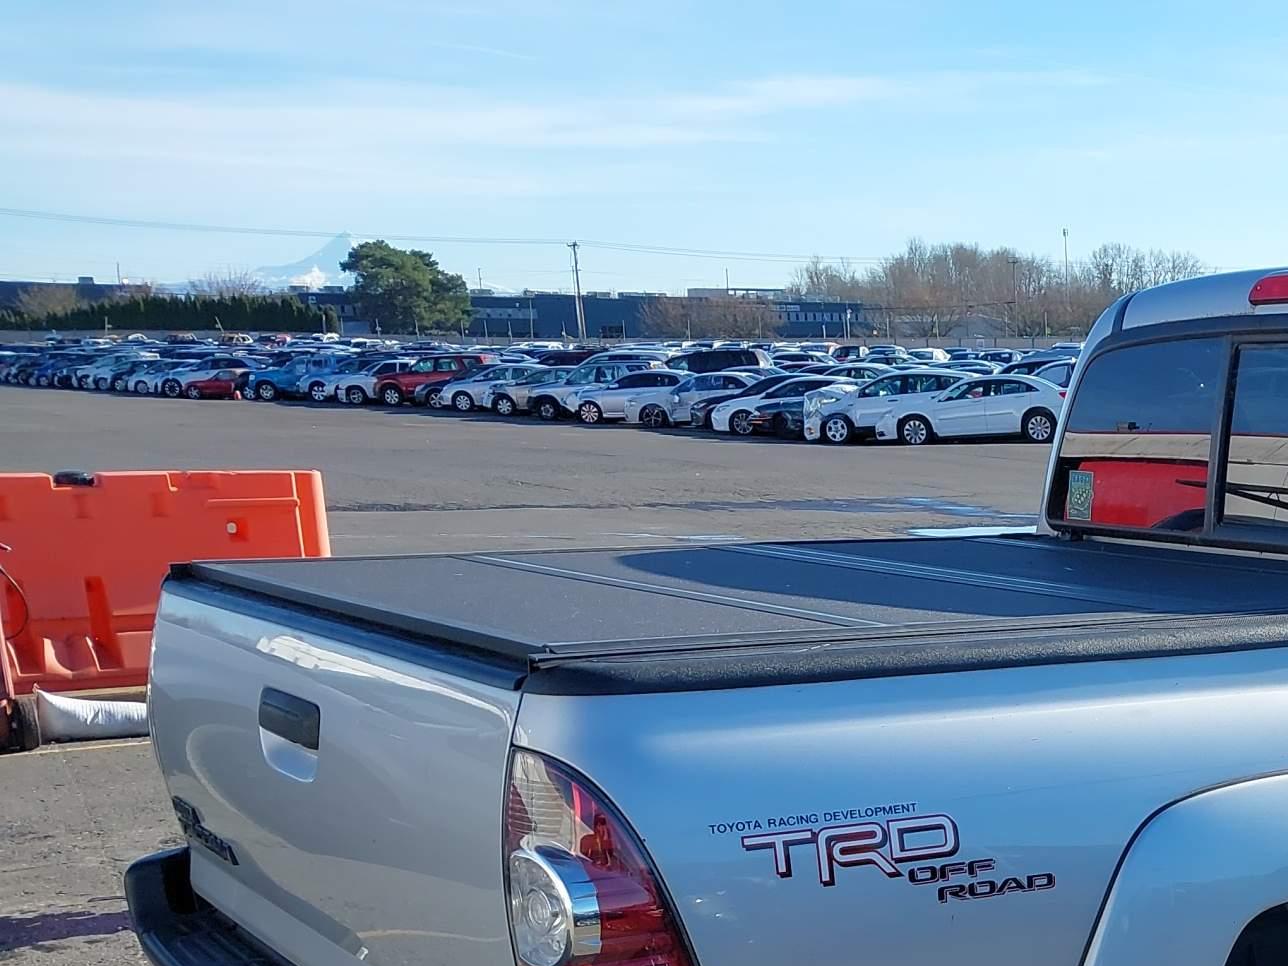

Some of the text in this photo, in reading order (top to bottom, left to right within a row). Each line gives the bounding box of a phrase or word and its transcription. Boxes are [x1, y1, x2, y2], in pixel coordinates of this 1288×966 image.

[709, 802, 918, 835] TOYOTA RACING DEVELOPMENT
[741, 813, 960, 887] TRD
[908, 858, 995, 886] OFF
[938, 872, 1055, 904] ROAD
